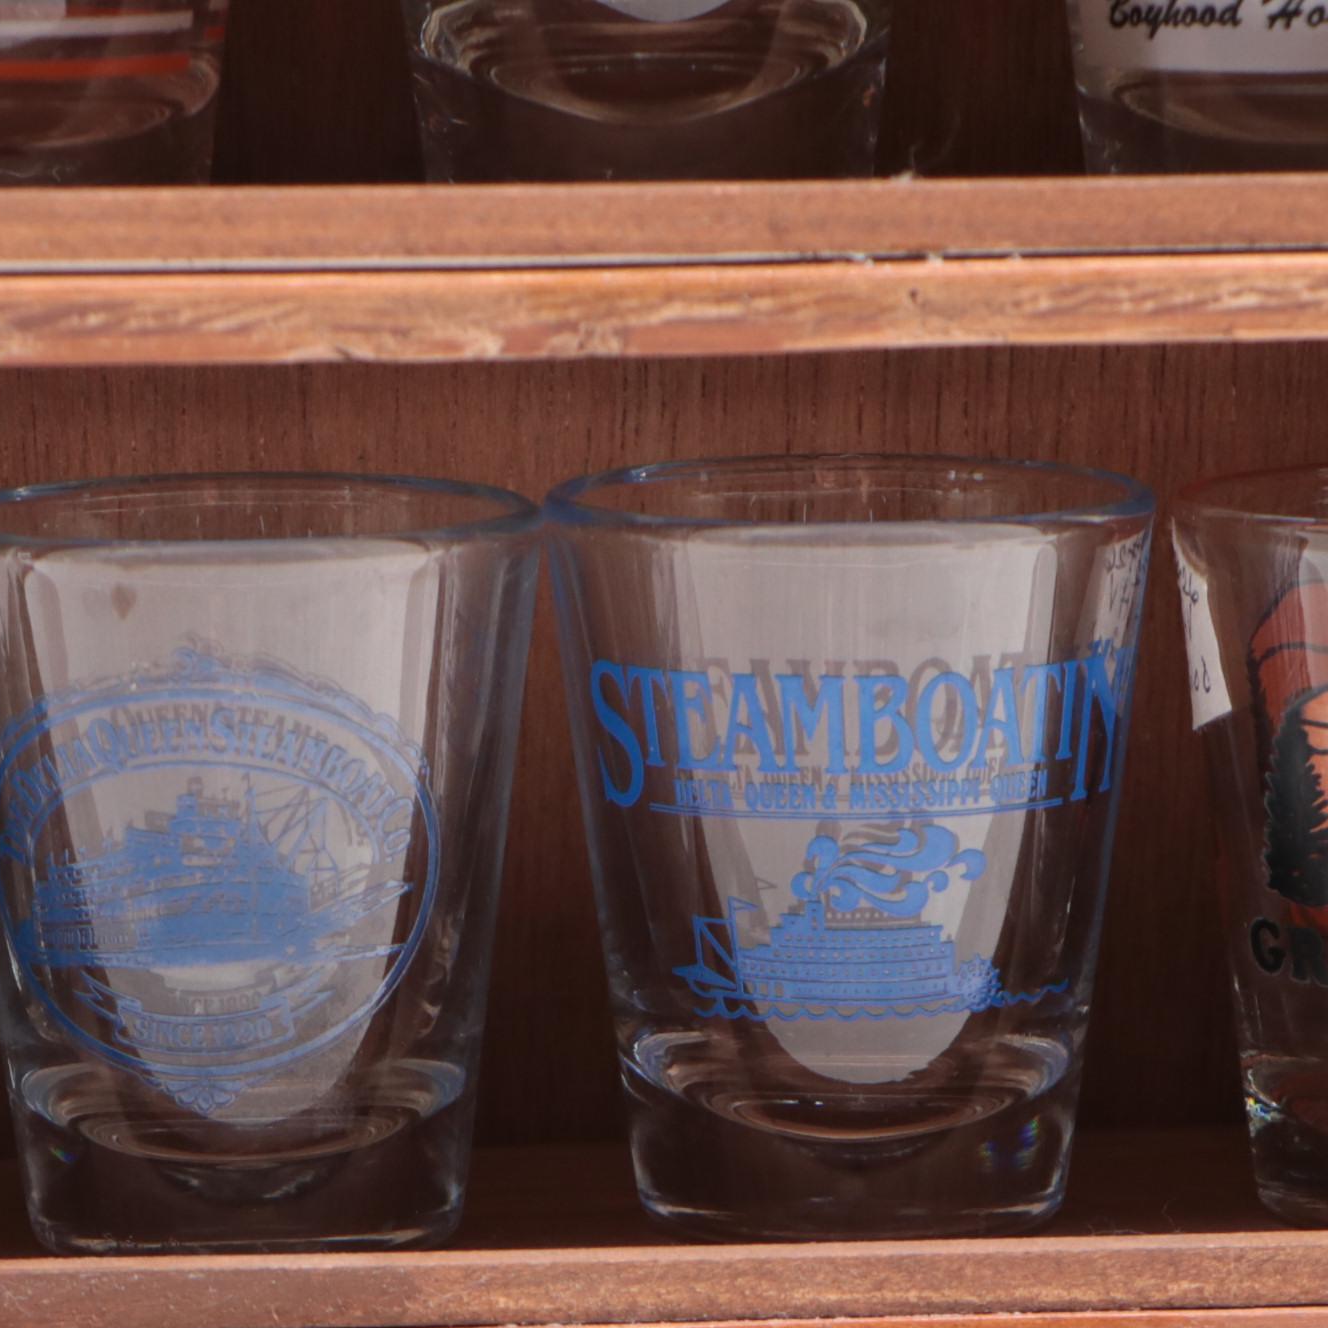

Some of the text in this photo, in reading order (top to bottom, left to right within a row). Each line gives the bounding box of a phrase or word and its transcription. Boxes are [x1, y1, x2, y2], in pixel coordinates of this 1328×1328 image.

[88, 717, 210, 769] QUEEN
[210, 706, 396, 816] STEAMBOAT
[674, 769, 1047, 811] DELTA QUEEN & MISSISSIPPI QUEEN
[133, 1017, 207, 1048] SINCE
